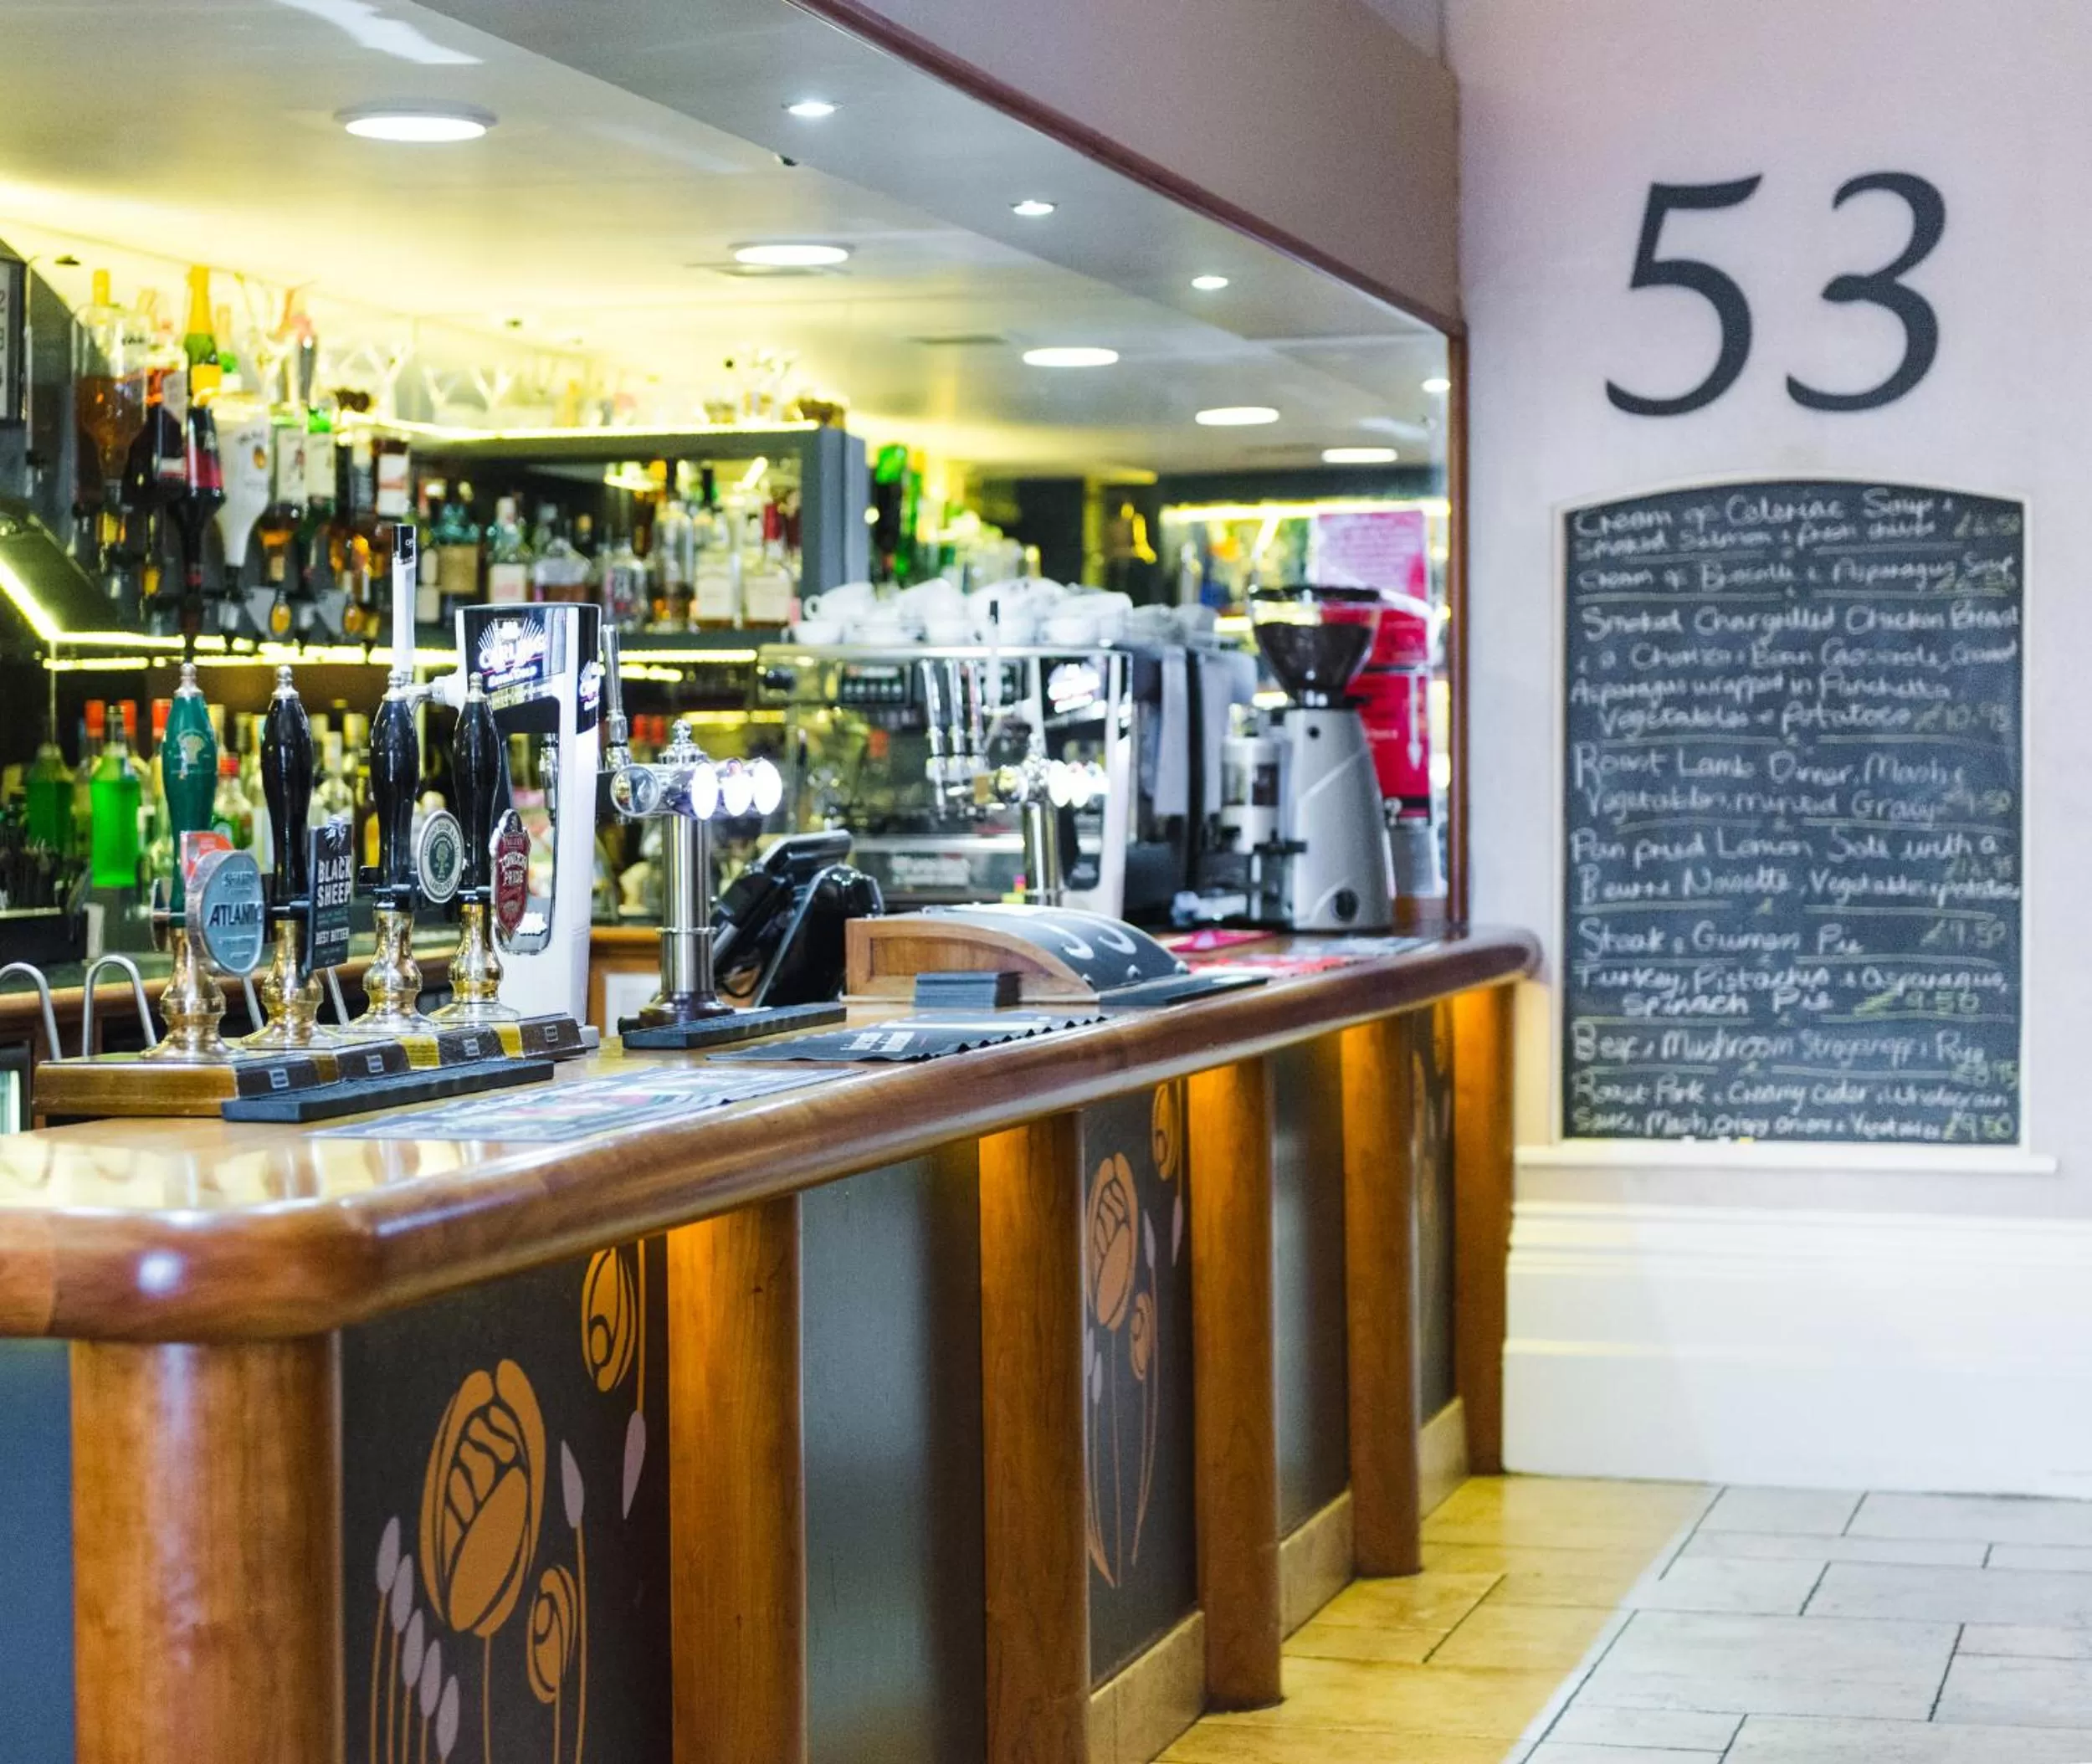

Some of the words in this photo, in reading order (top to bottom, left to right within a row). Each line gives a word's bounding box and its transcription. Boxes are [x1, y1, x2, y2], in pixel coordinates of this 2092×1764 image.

[1606, 172, 1946, 416] 53
[1574, 741, 1669, 789] Roast
[1677, 747, 1756, 779] Lamb
[317, 855, 351, 884] BLACK
[316, 880, 351, 909] SHEEP
